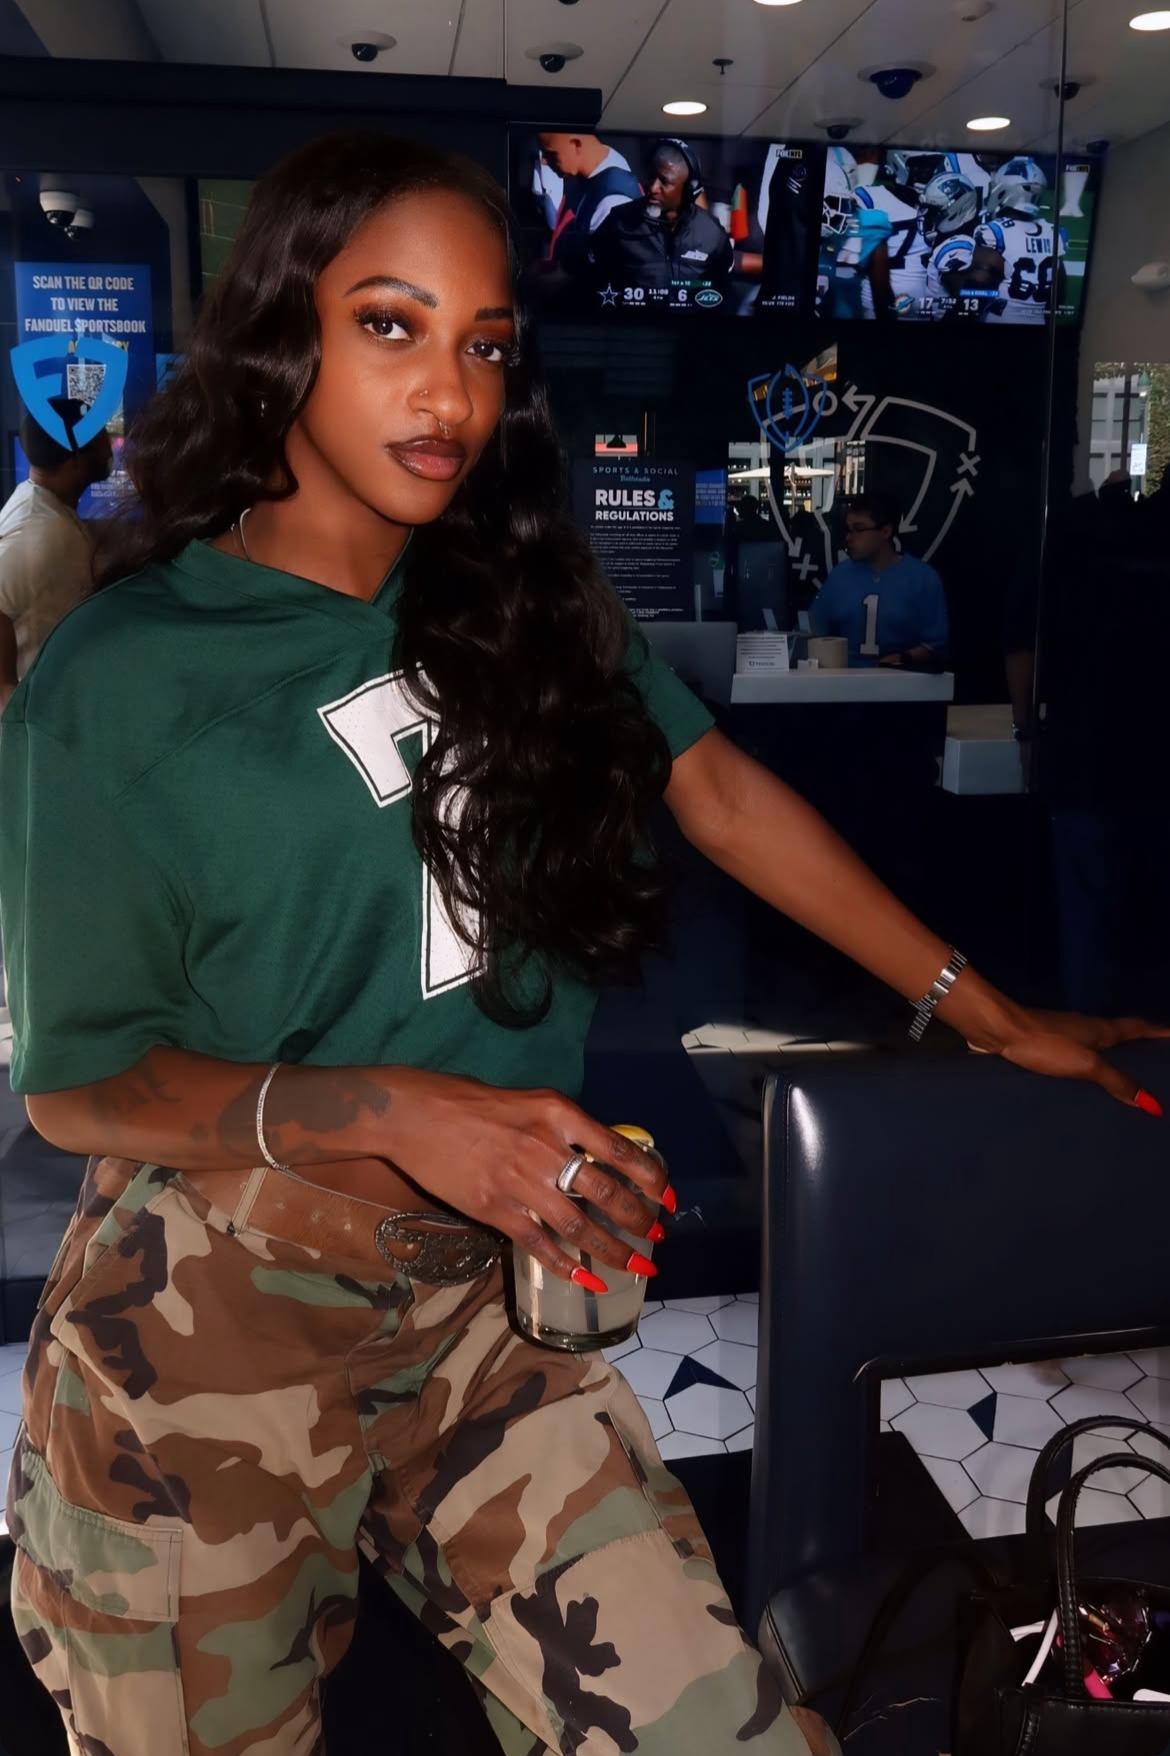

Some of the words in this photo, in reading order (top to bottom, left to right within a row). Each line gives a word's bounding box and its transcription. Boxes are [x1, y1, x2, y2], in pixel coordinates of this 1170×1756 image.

[33, 275, 62, 289] SCAN
[64, 276, 86, 290] THE
[88, 276, 103, 290] QR
[105, 277, 134, 290] CODE
[623, 287, 644, 300] 30
[678, 289, 688, 302] 6
[51, 297, 65, 311] TO
[67, 297, 95, 311] VIEW
[97, 297, 119, 312] THE
[919, 297, 933, 309] 17
[963, 298, 979, 311] 13
[25, 318, 74, 332] FANDUEL
[75, 318, 146, 333] SPORTSBOOK
[593, 466, 630, 474] SPORTS
[644, 467, 679, 475] SOCIAL
[595, 489, 656, 507] RULES
[657, 488, 675, 510] &
[595, 511, 674, 521] REGULATIONS
[860, 594, 880, 655] 1
